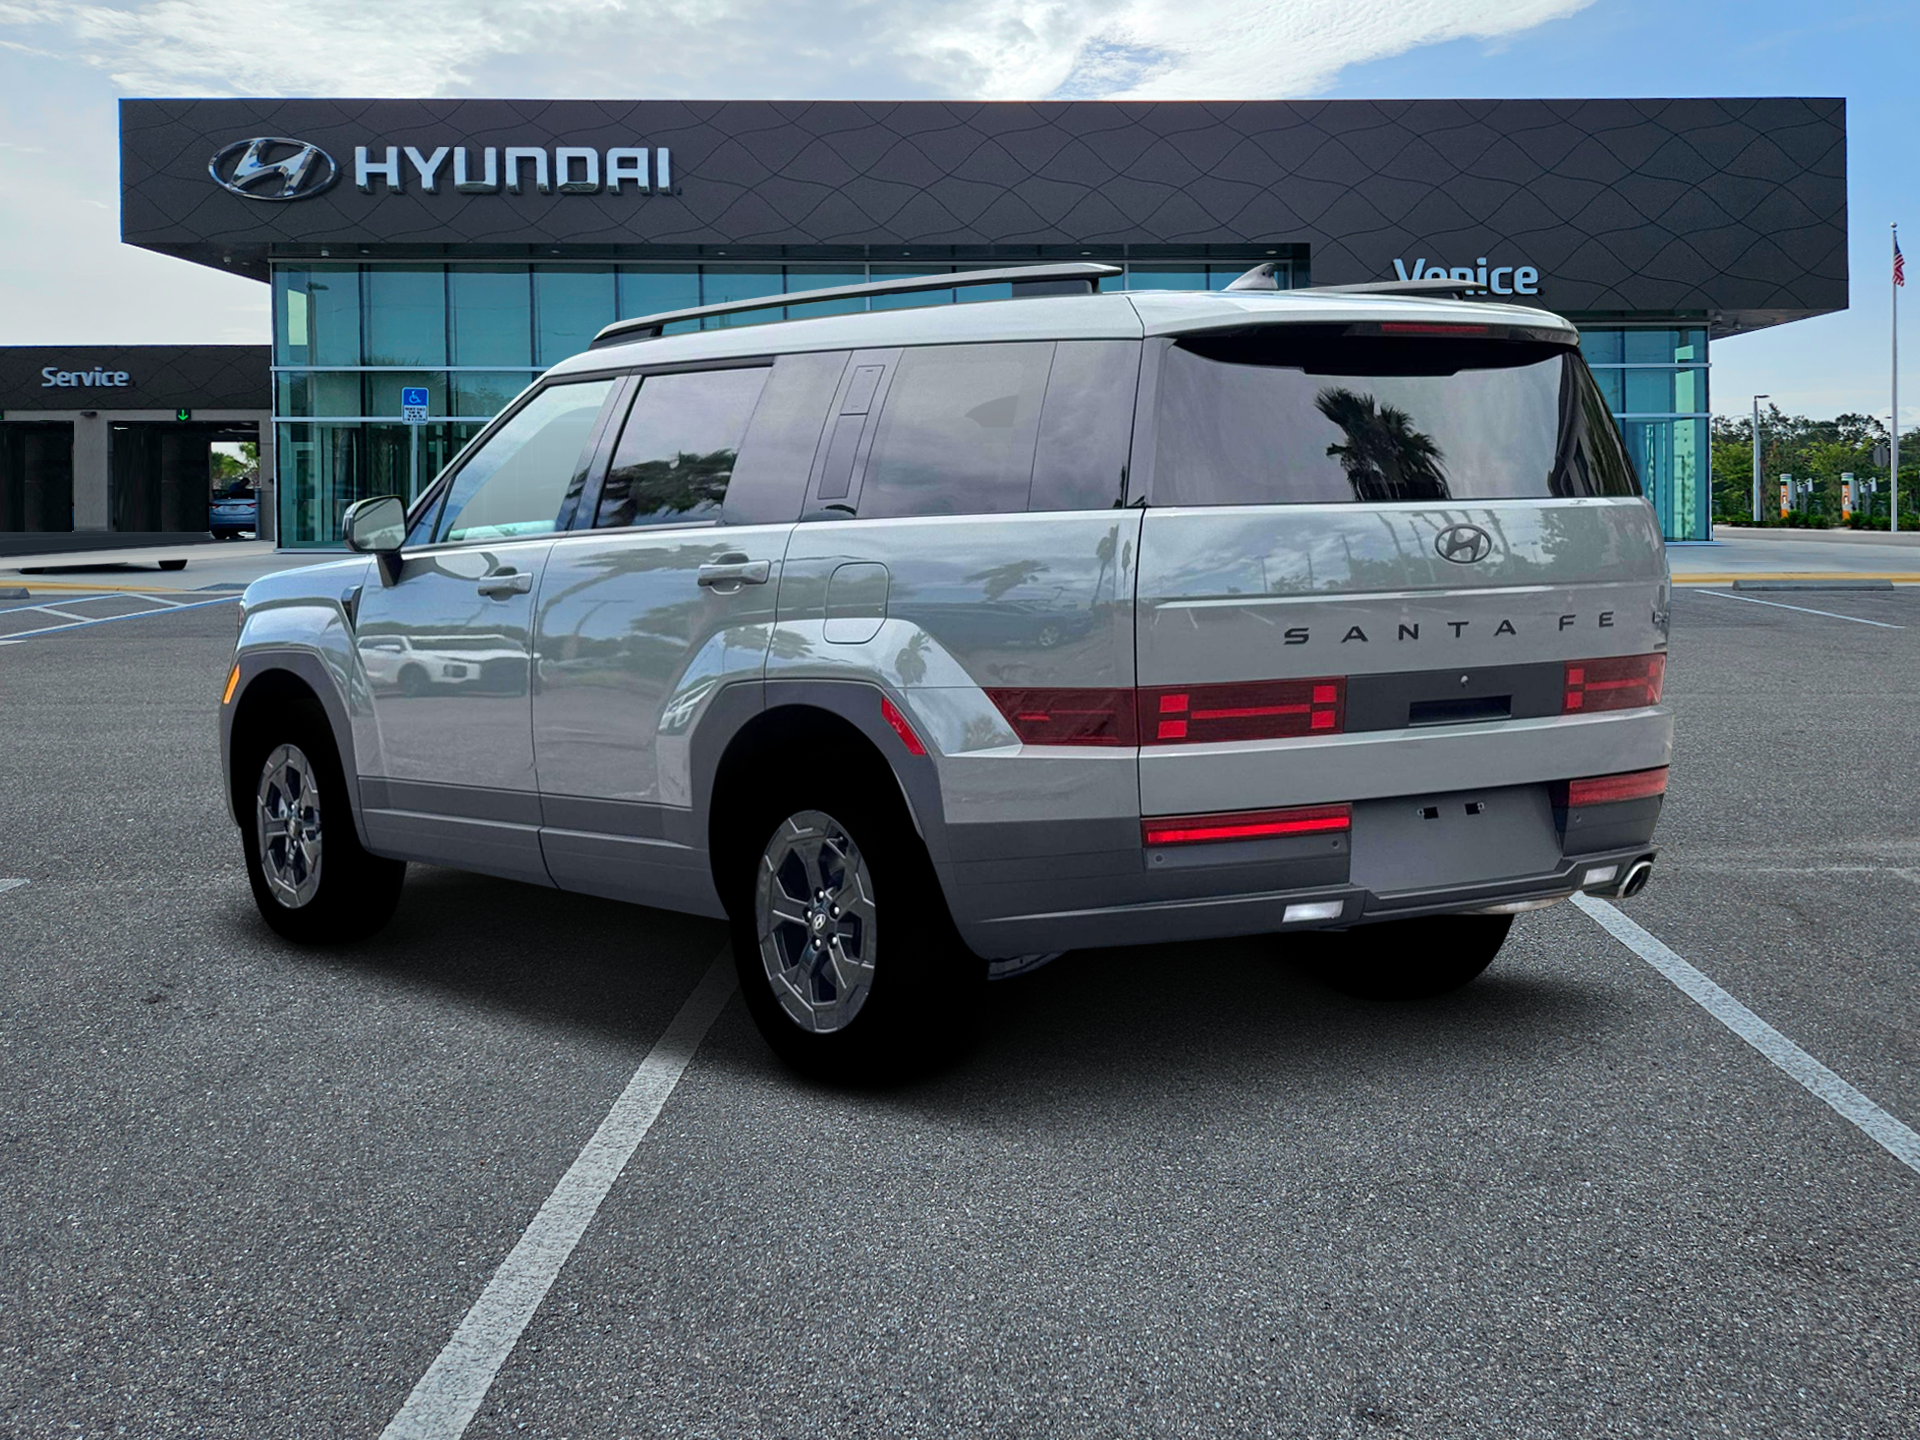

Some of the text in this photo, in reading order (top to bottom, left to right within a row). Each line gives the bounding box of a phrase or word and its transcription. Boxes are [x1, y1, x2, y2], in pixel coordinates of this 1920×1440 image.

[354, 146, 671, 194] HYUNDAI
[41, 366, 130, 387] Service
[1284, 611, 1615, 645] SANTA FE
